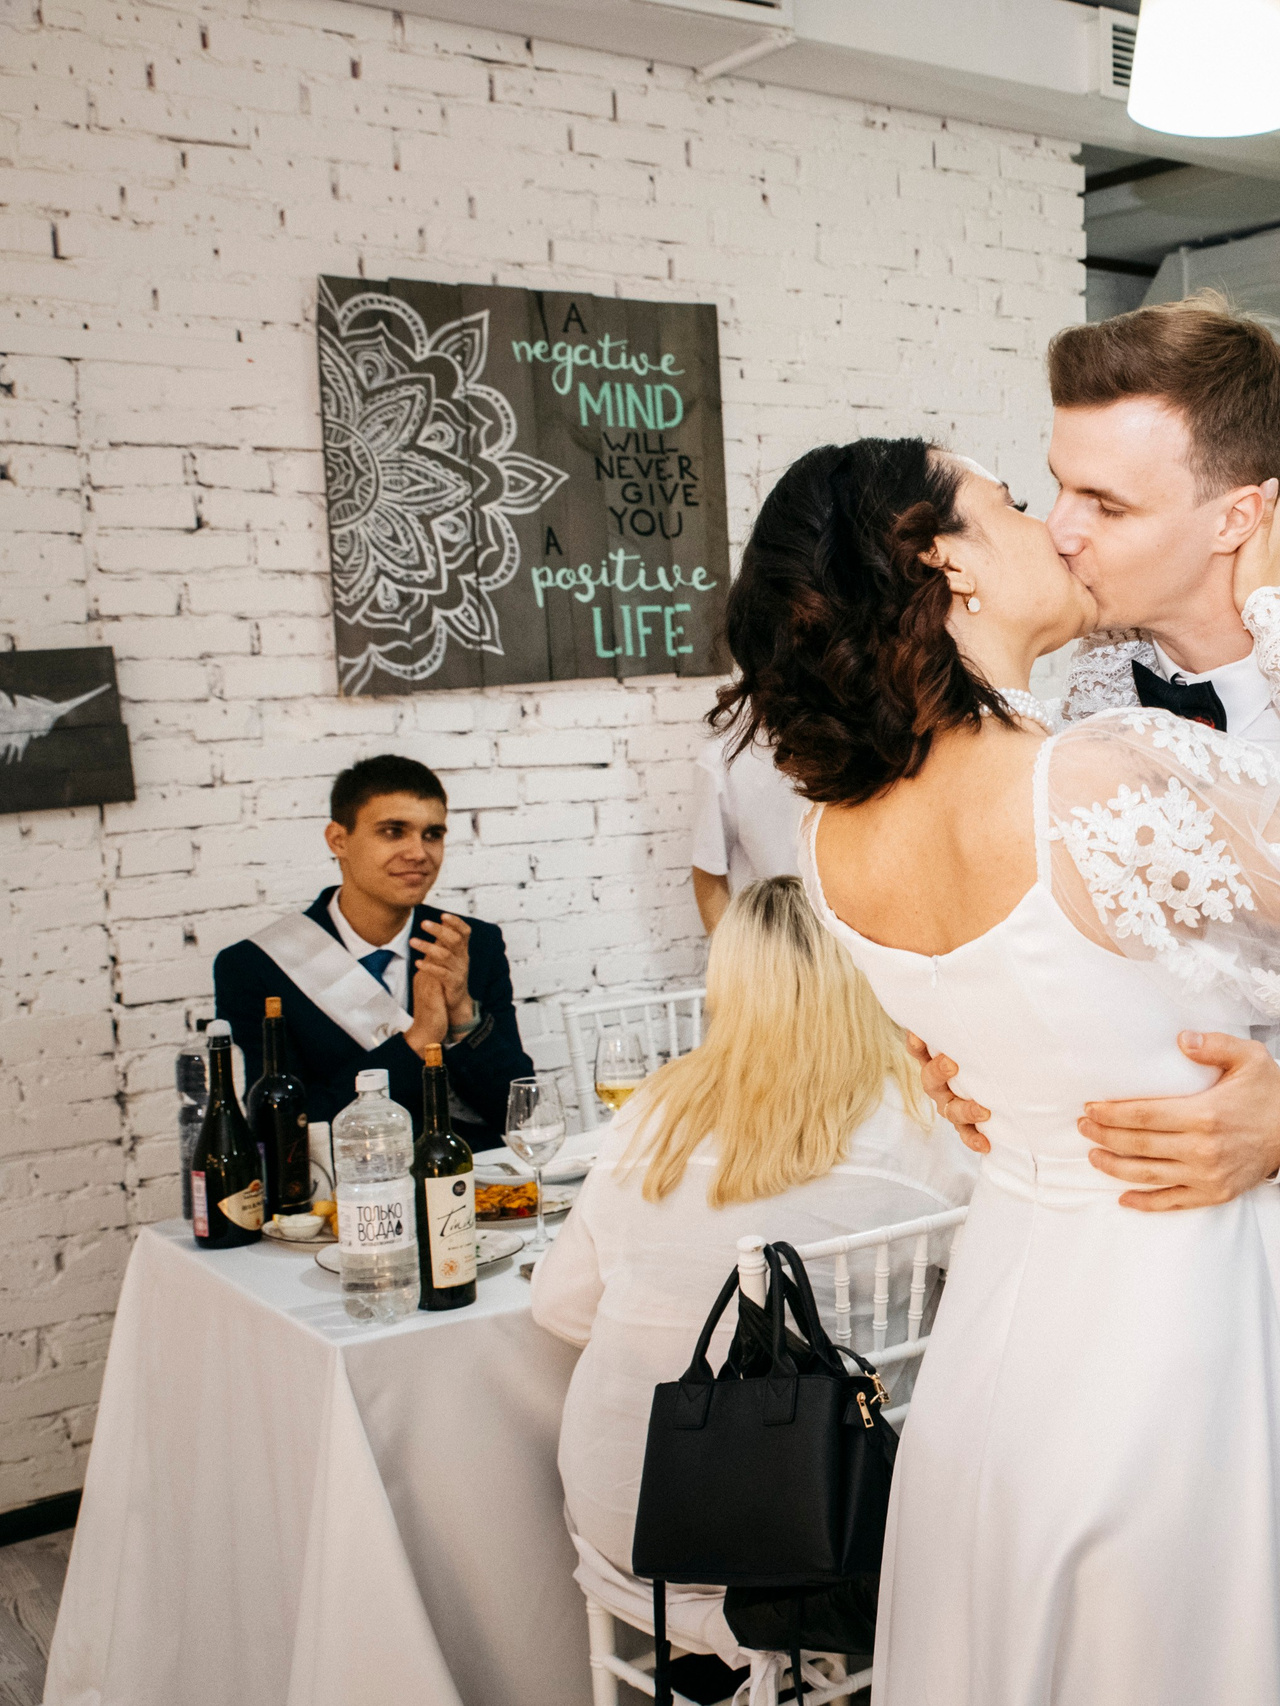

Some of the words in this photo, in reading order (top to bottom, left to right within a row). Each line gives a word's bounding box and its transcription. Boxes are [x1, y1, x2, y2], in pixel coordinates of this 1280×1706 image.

[562, 302, 588, 334] A
[511, 333, 685, 395] negative
[578, 381, 684, 430] MIND
[603, 431, 679, 456] WILL
[594, 454, 699, 481] NEVER
[621, 481, 699, 507] GIVE
[608, 506, 683, 540] YOU
[545, 526, 563, 556] A
[531, 548, 717, 608] positive
[592, 603, 694, 658] LIFE
[356, 1202, 403, 1223] ТОЛЬКО
[357, 1220, 396, 1242] ВОДА
